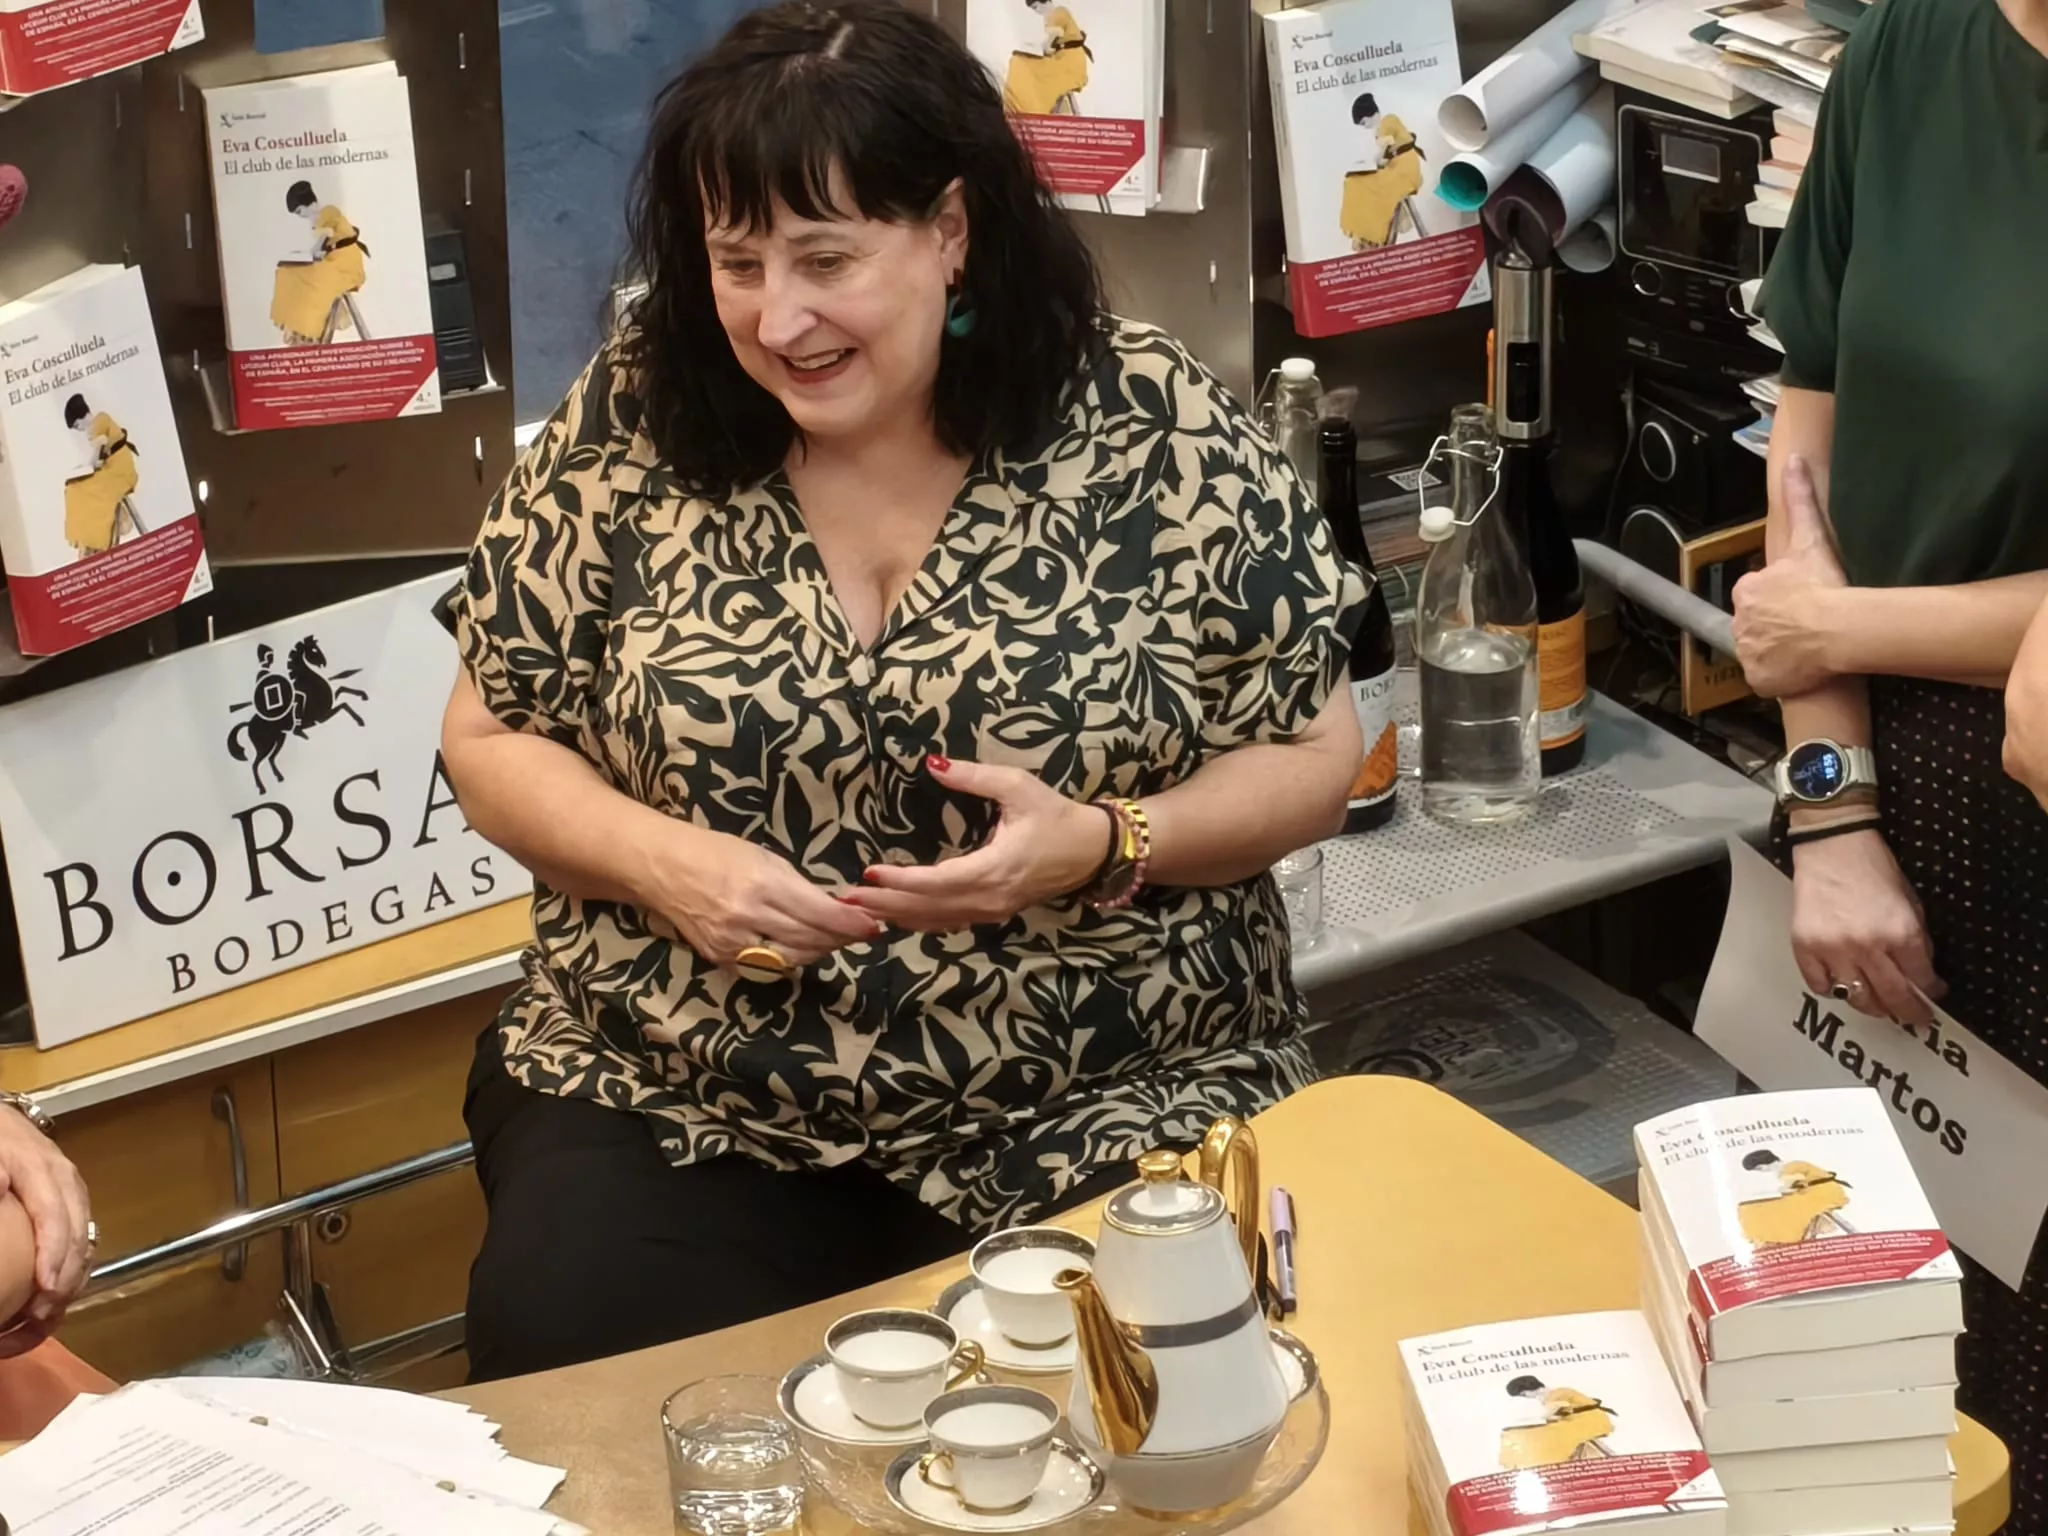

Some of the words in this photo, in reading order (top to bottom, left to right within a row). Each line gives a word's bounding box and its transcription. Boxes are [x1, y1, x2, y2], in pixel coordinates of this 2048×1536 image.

[1294, 59, 1320, 74] Eva
[1322, 40, 1404, 69] Cosculluela
[1295, 80, 1310, 95] El
[1312, 74, 1339, 92] club
[1342, 71, 1357, 85] de
[1359, 67, 1377, 83] las
[1379, 55, 1439, 78] modernas
[222, 139, 250, 153] Eva
[254, 128, 348, 150] Cosculluela
[224, 160, 239, 175] El
[242, 157, 272, 174] club
[275, 156, 293, 171] de
[296, 154, 315, 169] las
[318, 148, 389, 167] modernas
[4, 368, 30, 384] Eva
[31, 334, 107, 373] Cosculluela
[8, 389, 22, 406] El
[24, 380, 50, 400] club
[51, 374, 67, 390] de
[68, 368, 84, 383] las
[86, 345, 140, 377] modernas
[166, 856, 496, 994] BODEGAS
[1792, 991, 1968, 1156] Martos
[1660, 1137, 1692, 1153] Eva
[1664, 1152, 1681, 1166] El
[1726, 1137, 1746, 1149] de
[1749, 1134, 1774, 1144] las
[1778, 1127, 1864, 1140] modernas
[1422, 1359, 1457, 1372] Eva
[1461, 1341, 1575, 1364] Cosculluela
[1427, 1373, 1444, 1384] El
[1448, 1366, 1485, 1380] club
[1489, 1363, 1510, 1374] de
[1514, 1360, 1538, 1370] las
[1542, 1351, 1630, 1366] modernas
